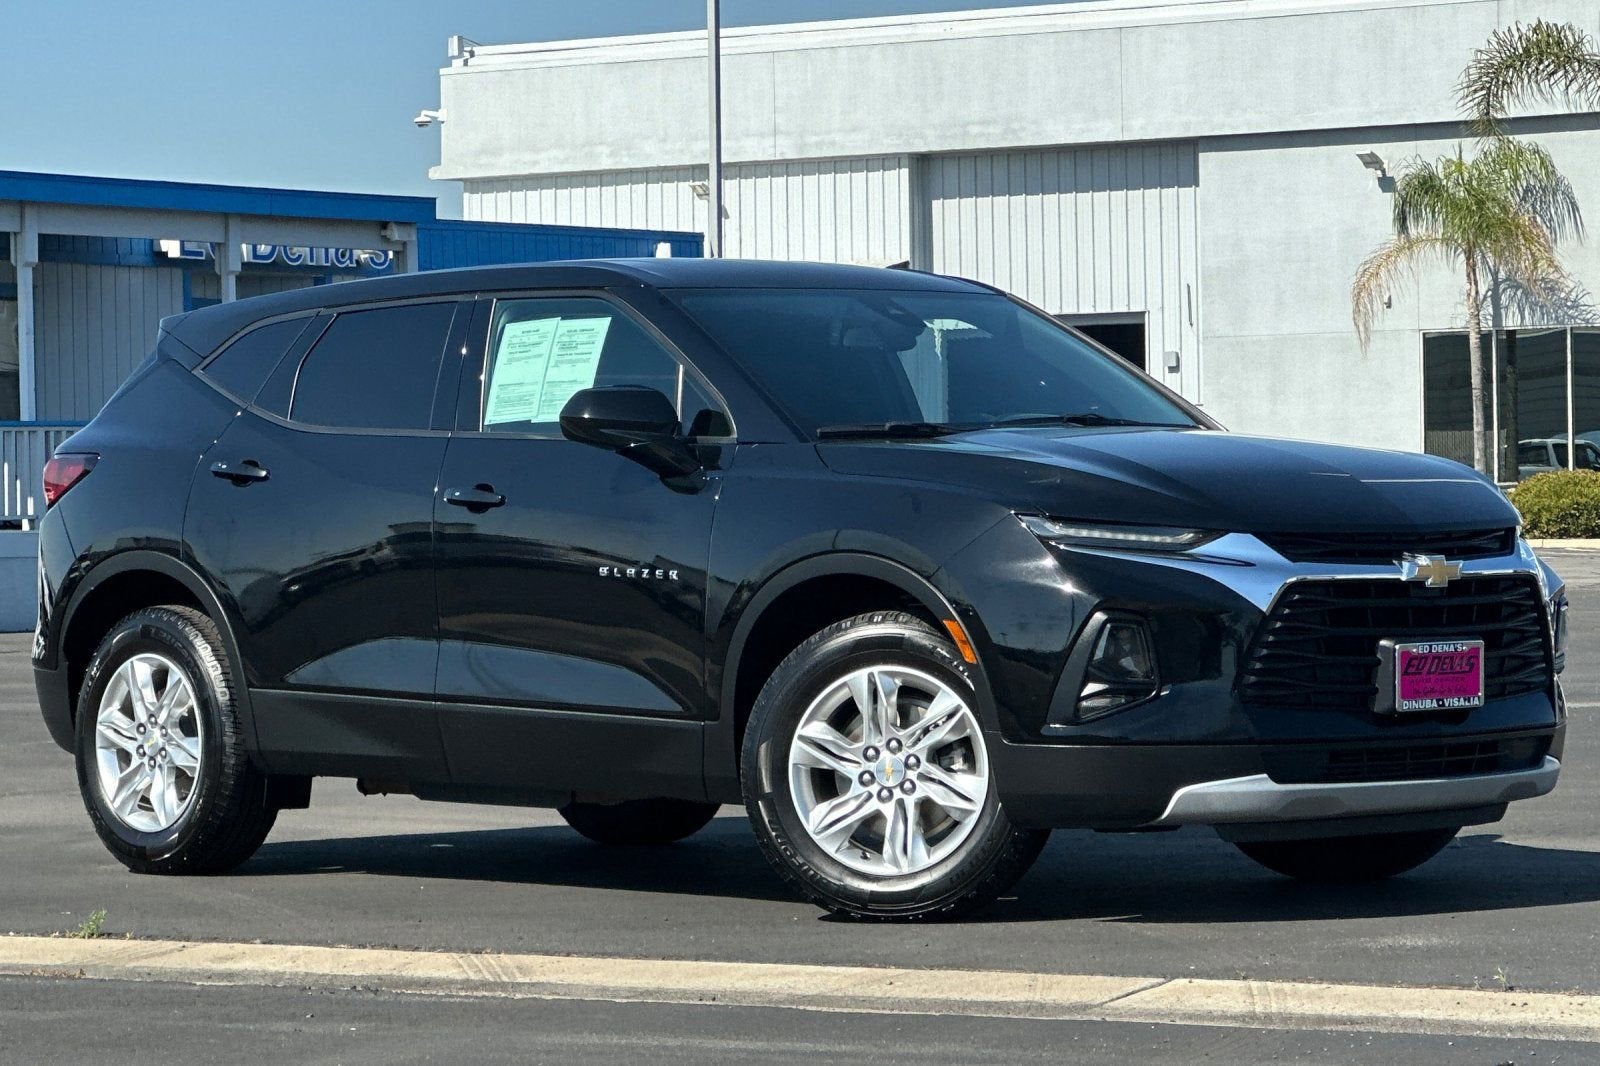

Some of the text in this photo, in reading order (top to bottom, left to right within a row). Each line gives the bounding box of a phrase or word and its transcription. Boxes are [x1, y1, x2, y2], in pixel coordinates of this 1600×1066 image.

[598, 566, 679, 580] BLAZER
[1418, 644, 1463, 653] ED DENA'S
[1402, 697, 1479, 709] DINUBA VISALIA
